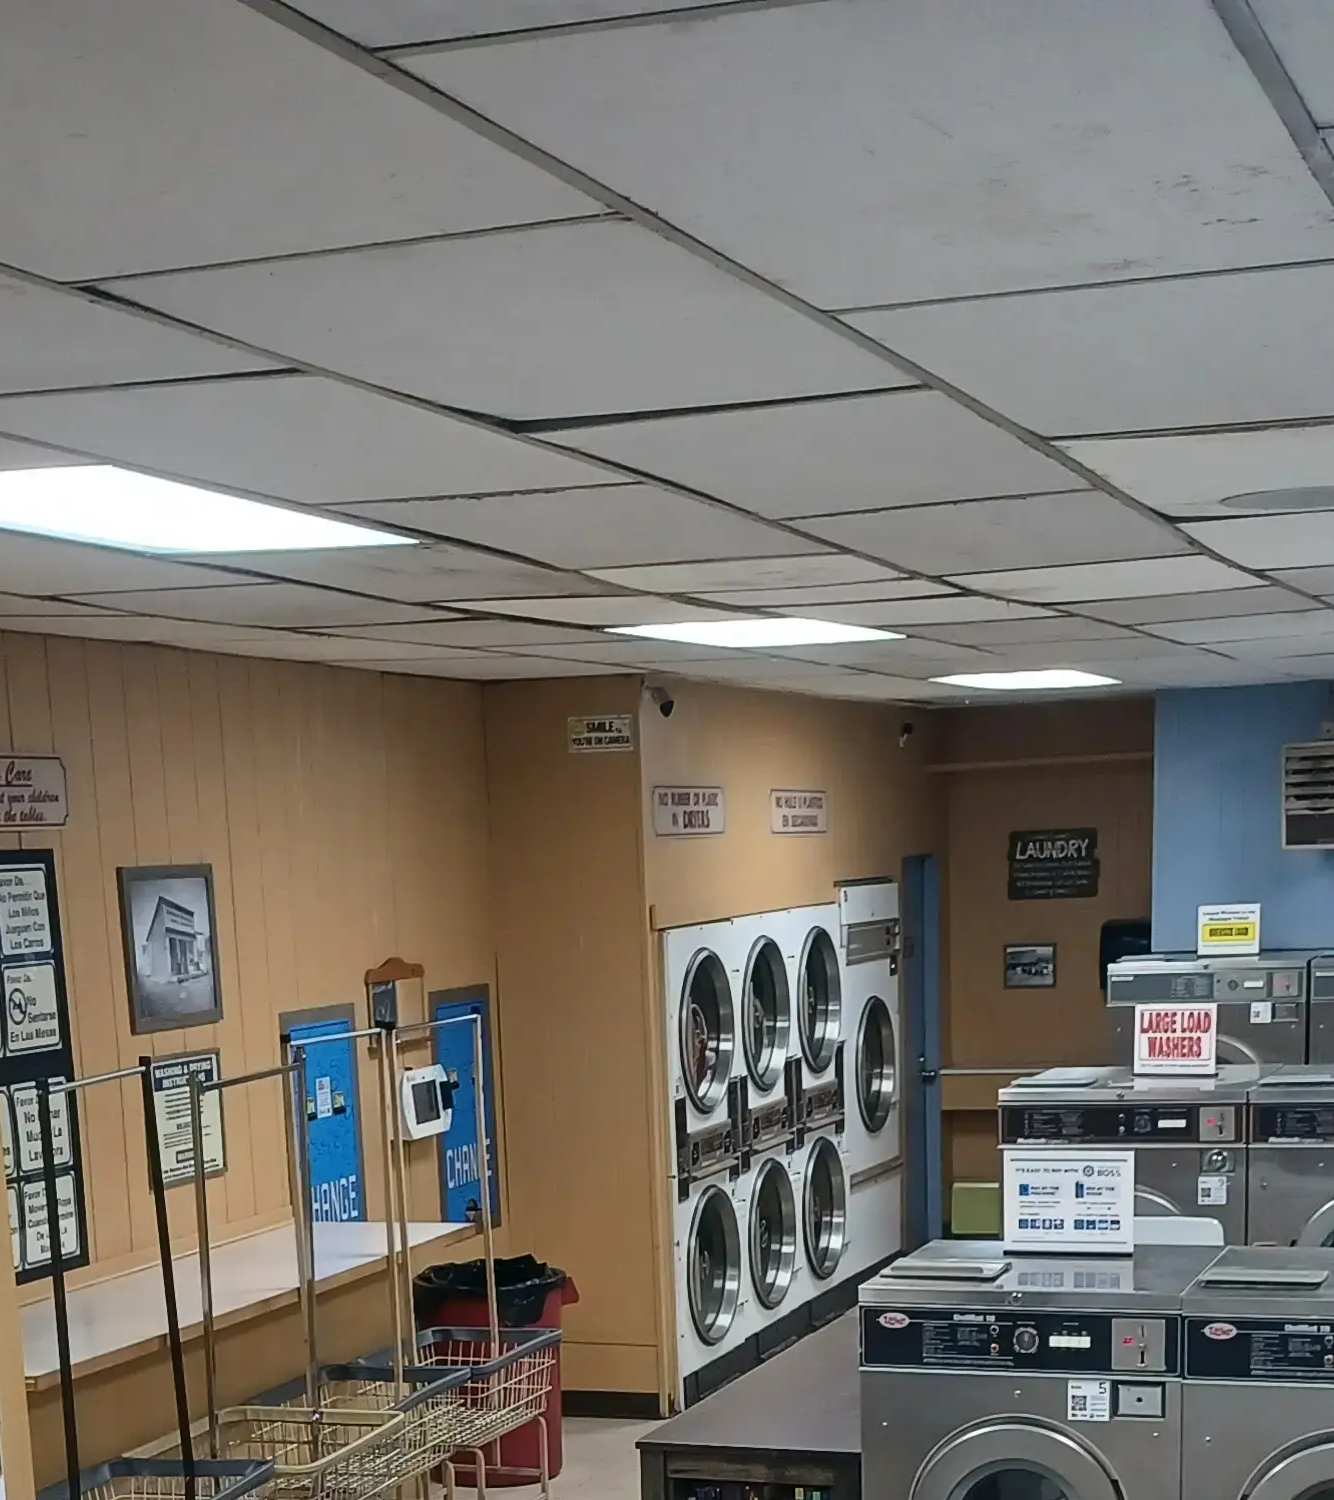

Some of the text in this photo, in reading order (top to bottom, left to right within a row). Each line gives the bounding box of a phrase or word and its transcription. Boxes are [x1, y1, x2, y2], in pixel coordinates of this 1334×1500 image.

[586, 721, 615, 733] SMILE
[594, 734, 630, 746] ON CAMERA
[5, 760, 33, 784] Care
[28, 788, 59, 804] children
[3, 810, 17, 823] the
[683, 810, 710, 829] DRYERS
[1015, 838, 1089, 860] LAUNDRY
[33, 890, 45, 901] Que
[27, 996, 37, 1006] No
[28, 1012, 57, 1023] Sentarse
[1140, 1011, 1212, 1034] LARGE LOAD
[10, 1028, 57, 1042] En Las Mesas
[1147, 1036, 1203, 1058] WASHERS
[24, 1111, 36, 1123] No
[445, 1137, 493, 1189] CHANE
[1097, 1169, 1121, 1177] BOSS
[311, 1174, 359, 1222] HANGE
[1098, 1381, 1107, 1395] 5
